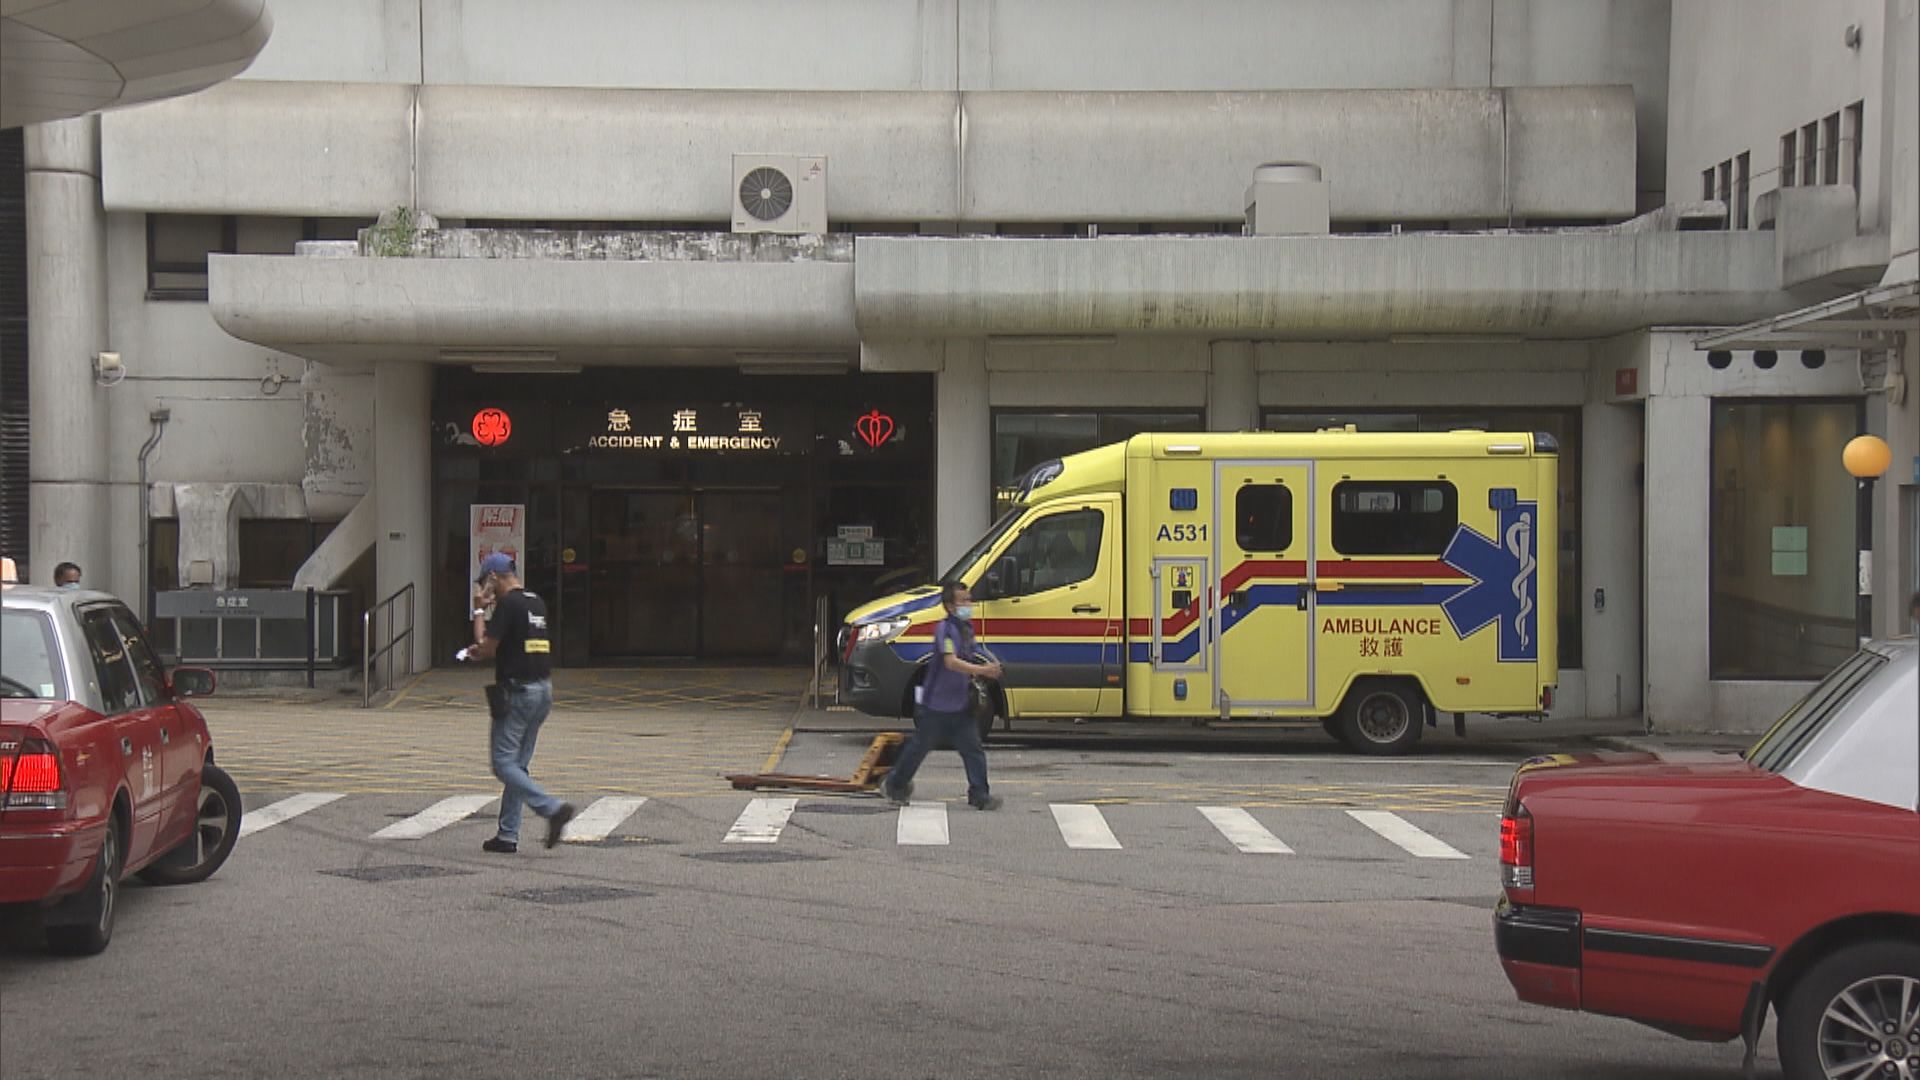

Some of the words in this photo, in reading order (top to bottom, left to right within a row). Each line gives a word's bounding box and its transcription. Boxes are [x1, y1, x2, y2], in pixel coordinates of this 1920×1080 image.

[588, 435, 663, 449] ACCIDENT
[669, 436, 680, 449] &
[687, 435, 781, 450] EMERGENCY
[1156, 523, 1207, 542] A531
[1322, 618, 1441, 635] AMBULANCE
[1359, 637, 1404, 657] 救護
